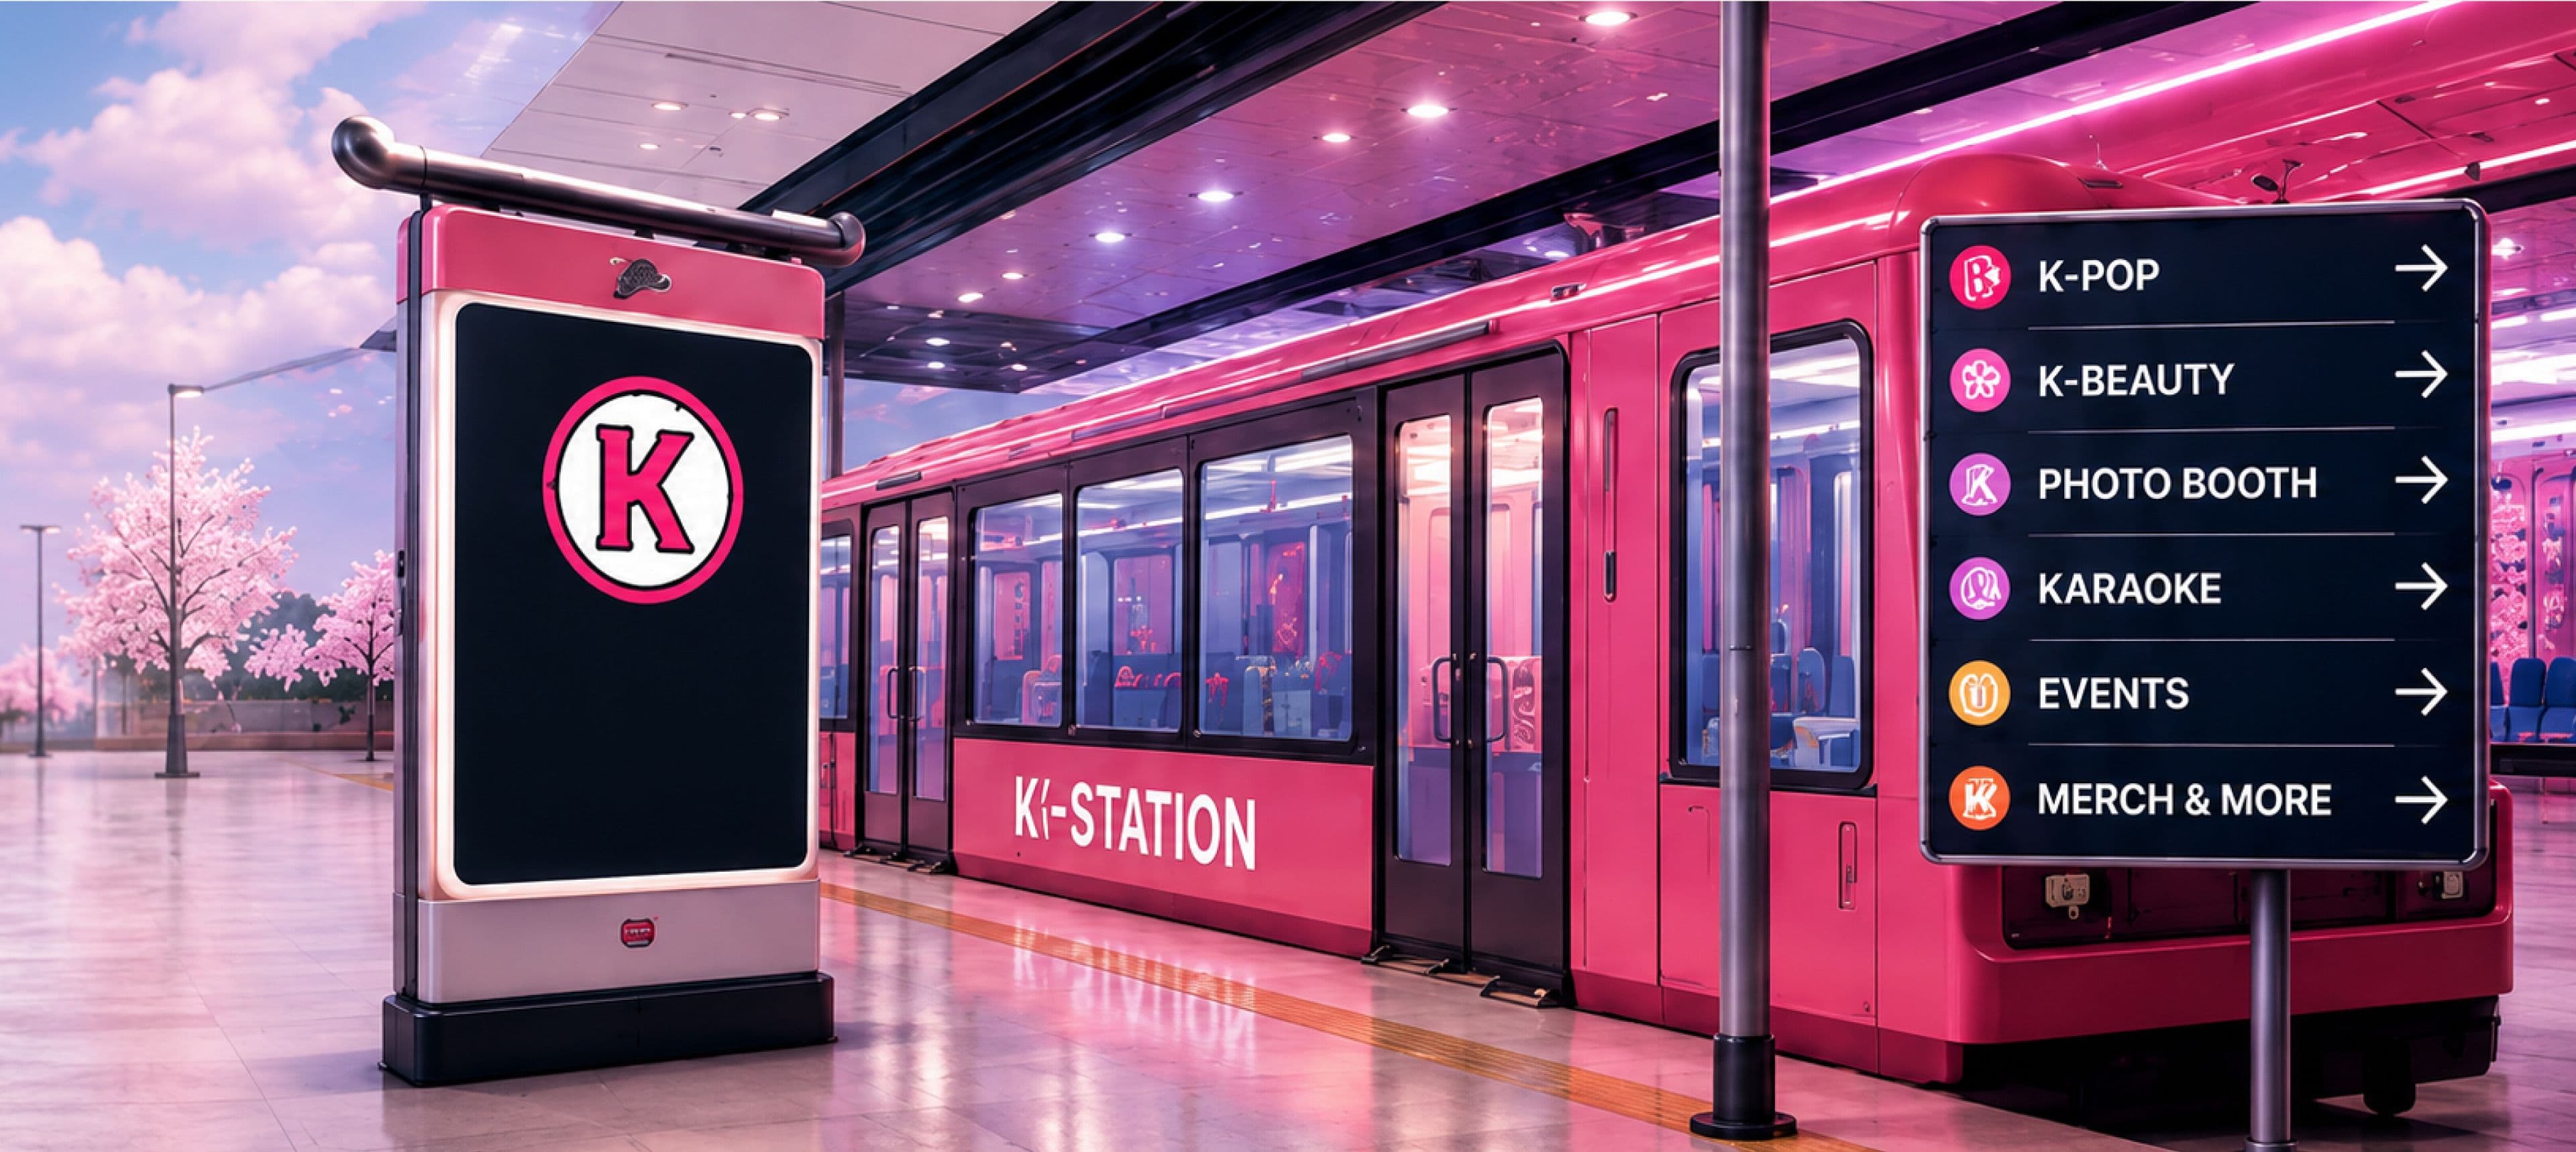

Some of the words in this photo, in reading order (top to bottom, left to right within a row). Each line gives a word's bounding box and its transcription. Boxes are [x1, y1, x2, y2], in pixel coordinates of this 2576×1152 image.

[2039, 258, 2160, 292] K-POP
[2039, 363, 2235, 397] K-BEAUTY
[596, 423, 694, 554] K
[2039, 466, 2171, 500] PHOTO
[2183, 466, 2317, 500] BOOTH
[2039, 571, 2222, 605] KARAOKE
[2039, 676, 2190, 709] EVENTS
[2038, 782, 2174, 815] MERCH
[2185, 782, 2212, 816] &
[2222, 782, 2332, 816] MORE
